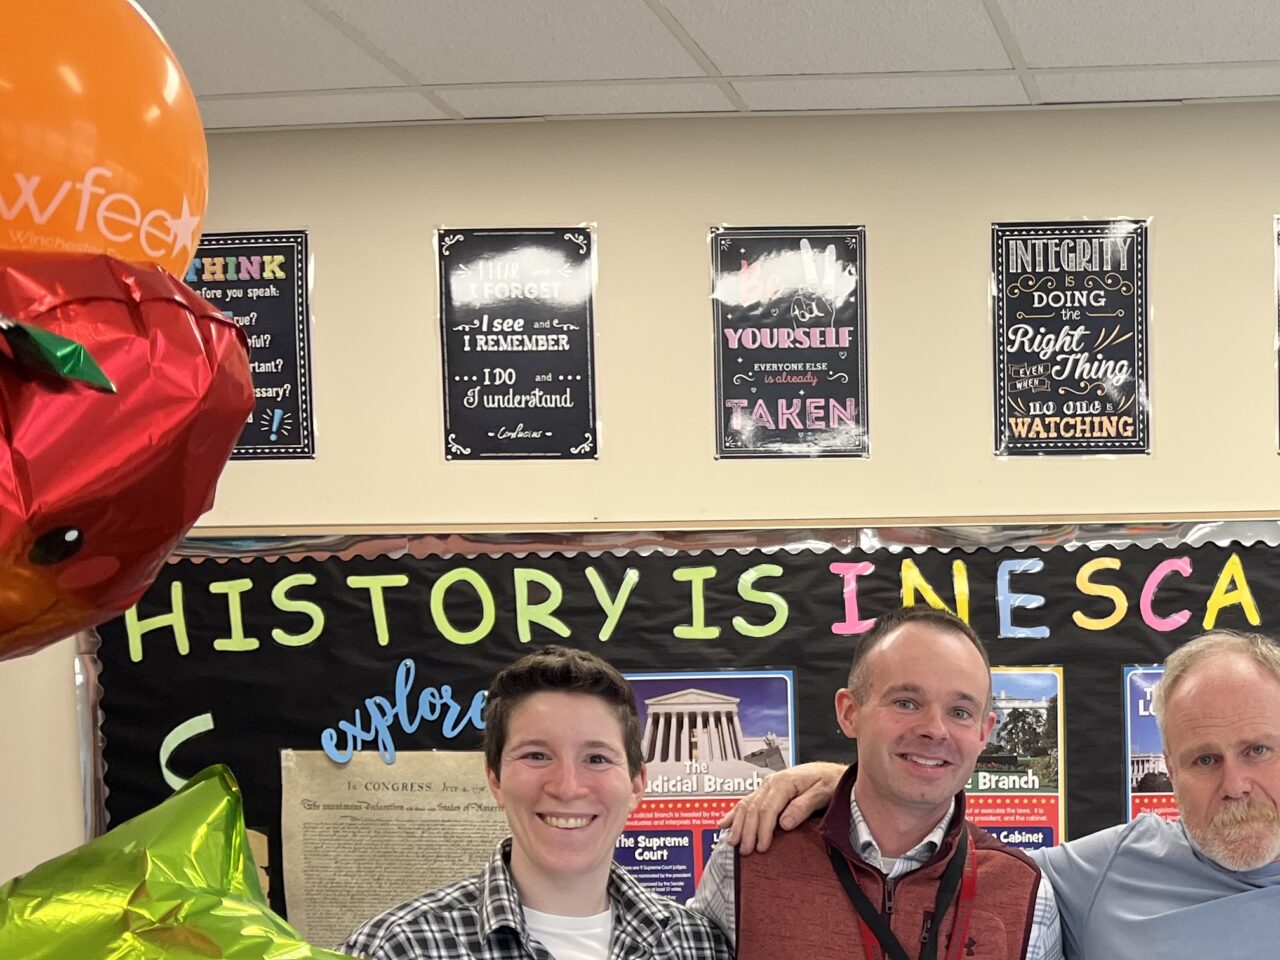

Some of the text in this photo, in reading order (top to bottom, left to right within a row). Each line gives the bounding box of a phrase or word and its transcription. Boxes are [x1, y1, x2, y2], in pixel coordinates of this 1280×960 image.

[1008, 238, 1132, 273] INTEGRITY
[226, 289, 243, 301] you
[248, 285, 279, 300] speak:
[484, 282, 562, 298] FORGET
[1033, 290, 1106, 308] DOING
[1061, 308, 1081, 320] the
[482, 315, 550, 331] I see and
[464, 335, 570, 351] I REMEMBER
[724, 327, 854, 349] YOURSELF
[1007, 324, 1090, 360] Right
[754, 363, 804, 371] EVERYONE
[1020, 366, 1044, 376] EVEN
[1051, 354, 1131, 385] Thing
[484, 368, 490, 385] I
[493, 368, 516, 385] DO
[765, 372, 818, 386] is already
[1016, 379, 1039, 389] WHEN
[463, 386, 574, 408] I understand
[725, 398, 856, 429] TAKEN
[1029, 401, 1056, 415] no
[1064, 400, 1101, 414] one
[1009, 416, 1134, 439] WATCHING
[125, 566, 640, 662] HISTORY
[672, 563, 789, 639] IS
[684, 761, 708, 774] The
[704, 772, 763, 792] Branch
[978, 769, 1039, 789] Branch
[638, 835, 689, 852] Supreme
[1000, 831, 1043, 843] Cabinet
[635, 848, 668, 861] Court
